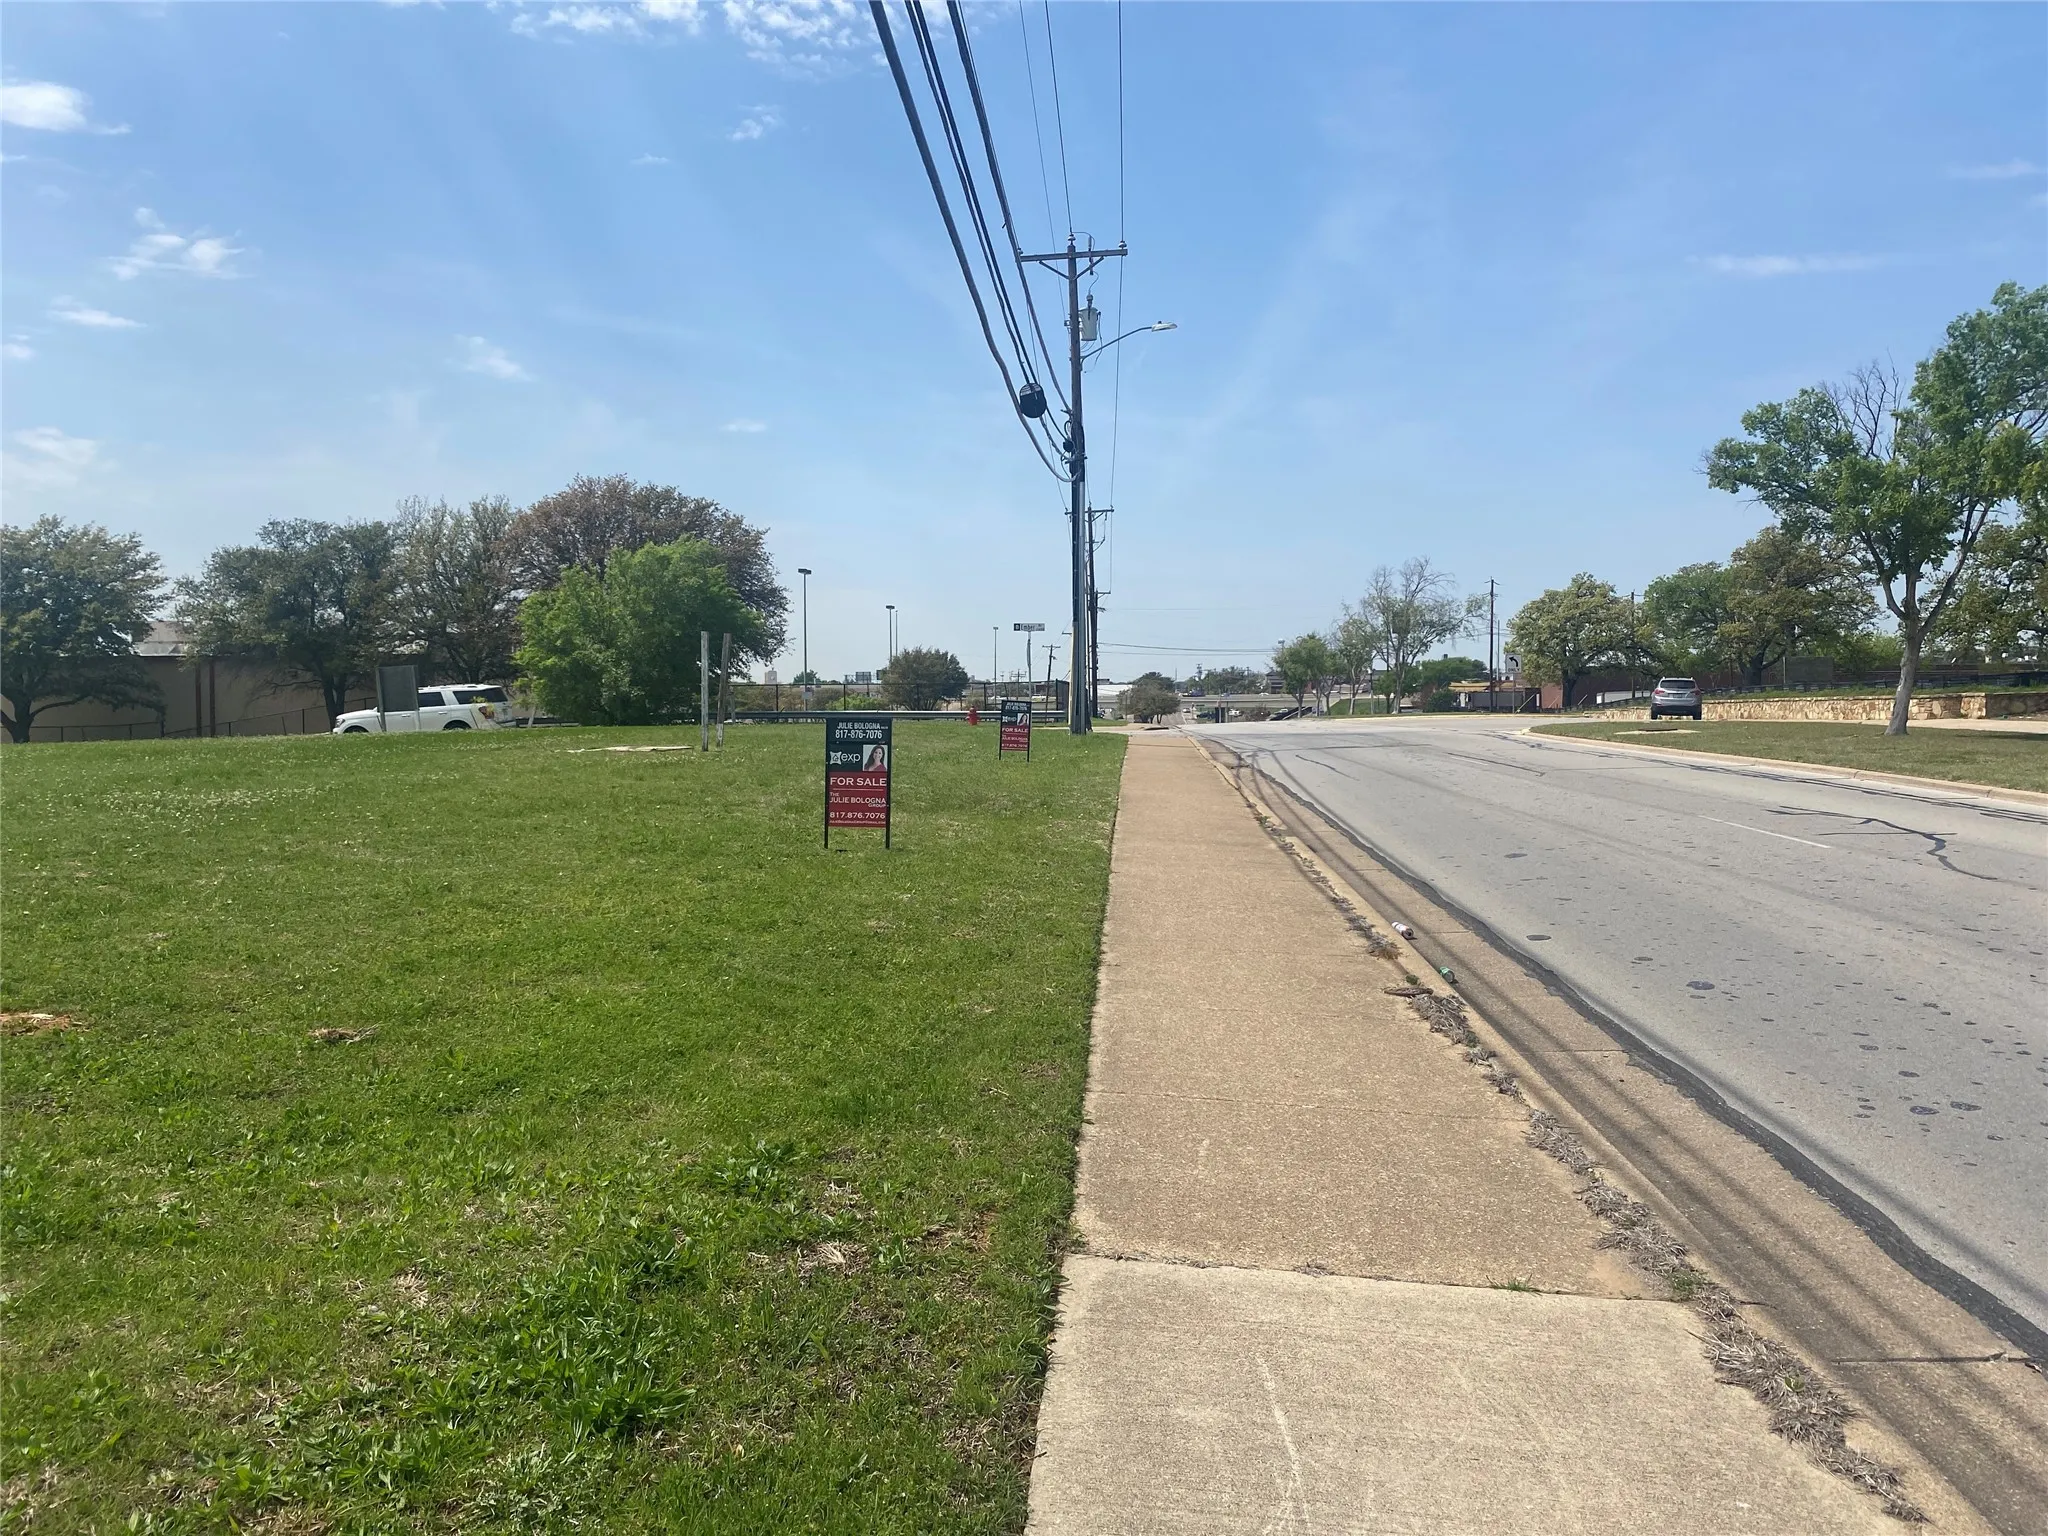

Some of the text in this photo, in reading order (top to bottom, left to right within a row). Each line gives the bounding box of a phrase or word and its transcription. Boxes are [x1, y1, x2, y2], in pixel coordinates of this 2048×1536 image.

[854, 722, 881, 730] BOLOGNA
[835, 729, 883, 739] 817-876-7076
[841, 753, 861, 763] exp
[830, 777, 887, 786] FOR SALE
